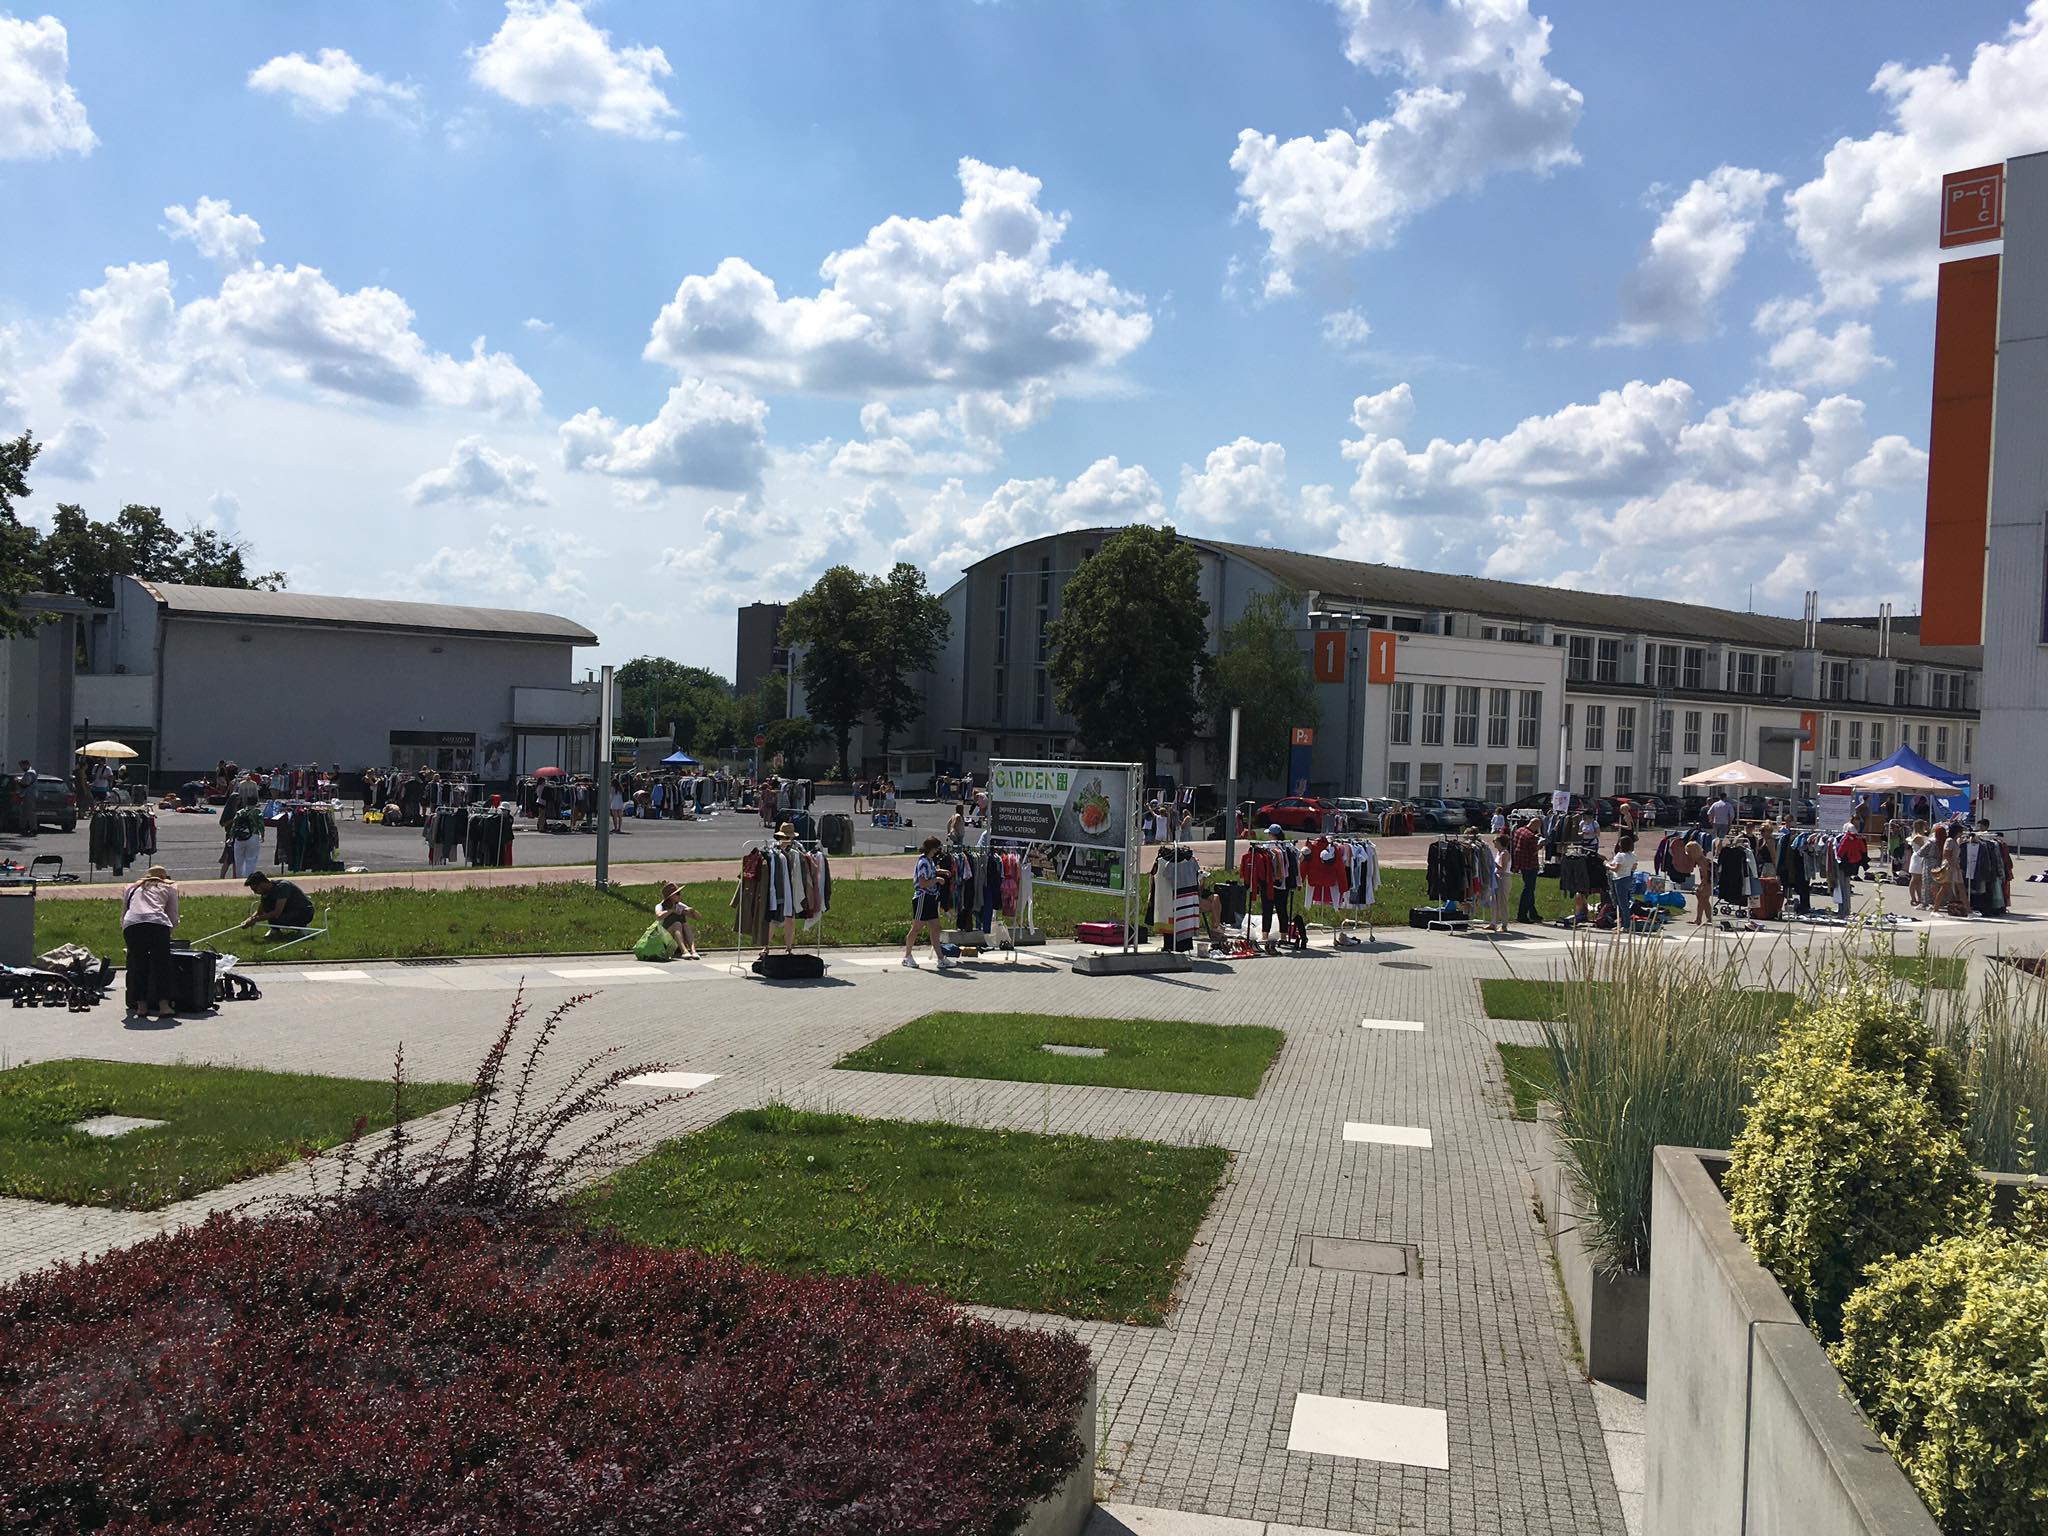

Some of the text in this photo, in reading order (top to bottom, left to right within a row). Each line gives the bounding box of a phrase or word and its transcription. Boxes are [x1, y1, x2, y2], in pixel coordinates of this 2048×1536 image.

[1326, 640, 1334, 673] 1
[1379, 640, 1387, 674] 1
[1296, 729, 1308, 743] P2
[995, 770, 1055, 790] GARDEN
[1983, 785, 1990, 799] H
[998, 814, 1049, 824] SPOTKANIA BIZNESOWE
[1014, 826, 1037, 834] CATERING
